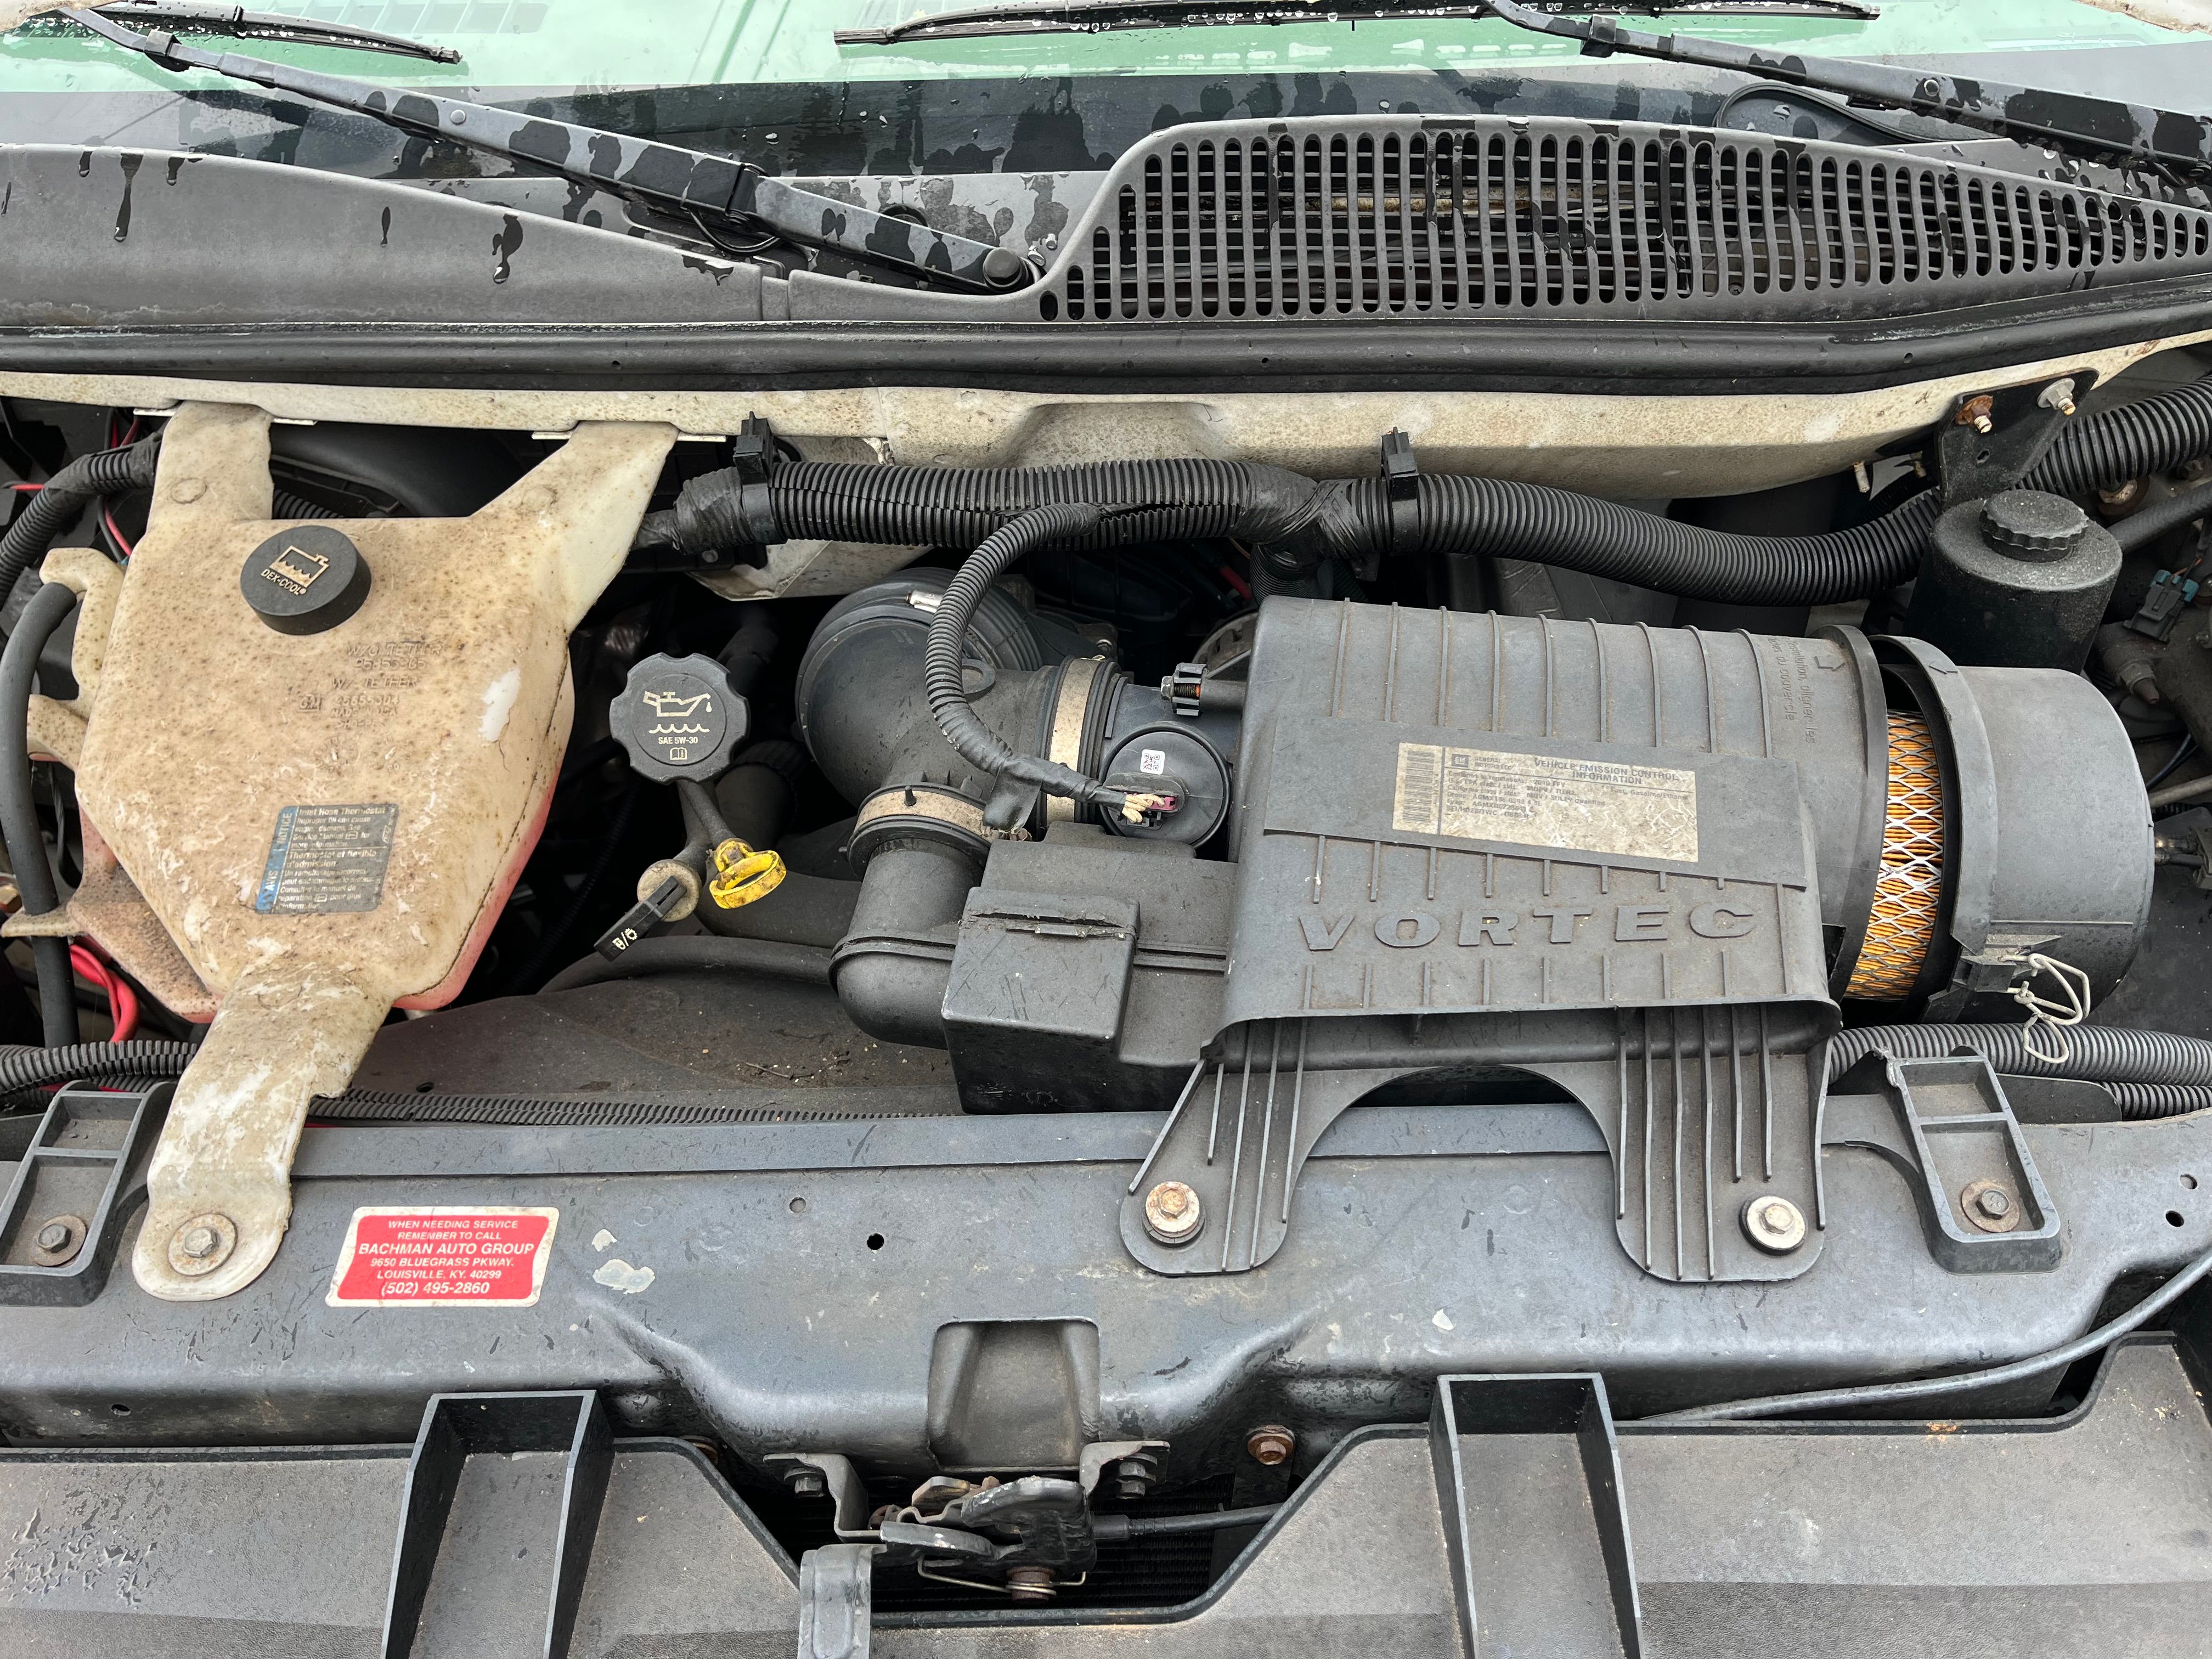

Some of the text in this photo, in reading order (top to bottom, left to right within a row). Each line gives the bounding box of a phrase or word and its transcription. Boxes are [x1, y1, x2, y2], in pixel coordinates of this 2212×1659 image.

[365, 675, 418, 689] TETHER
[1780, 669, 1798, 720] couvercle
[1798, 685, 1814, 723] aligner
[658, 736, 698, 744] SAE 5W-30
[1805, 727, 1818, 743] les
[1535, 759, 1679, 781] VEHICLE EMISSION CONTROL
[1572, 771, 1642, 785] INFORMATION
[1448, 785, 1478, 793] California
[1630, 789, 1688, 800] Gasoline/Ethanol
[319, 808, 338, 816] Hose
[341, 806, 386, 815] Thermostat
[276, 812, 292, 844] NOTICE
[1298, 902, 1754, 952] VORTEC
[388, 1220, 518, 1229] WHEN NEEDING SERVICE
[397, 1231, 503, 1240] REMEMBER TO CALL
[358, 1243, 535, 1255] BACHMAN AUTO GROUP
[370, 1257, 514, 1267] 9650 BLUEGRASS PKWAY.
[377, 1269, 502, 1280] LOUISVILLE, KY. 40299
[381, 1282, 490, 1297] (502) 495-2860
